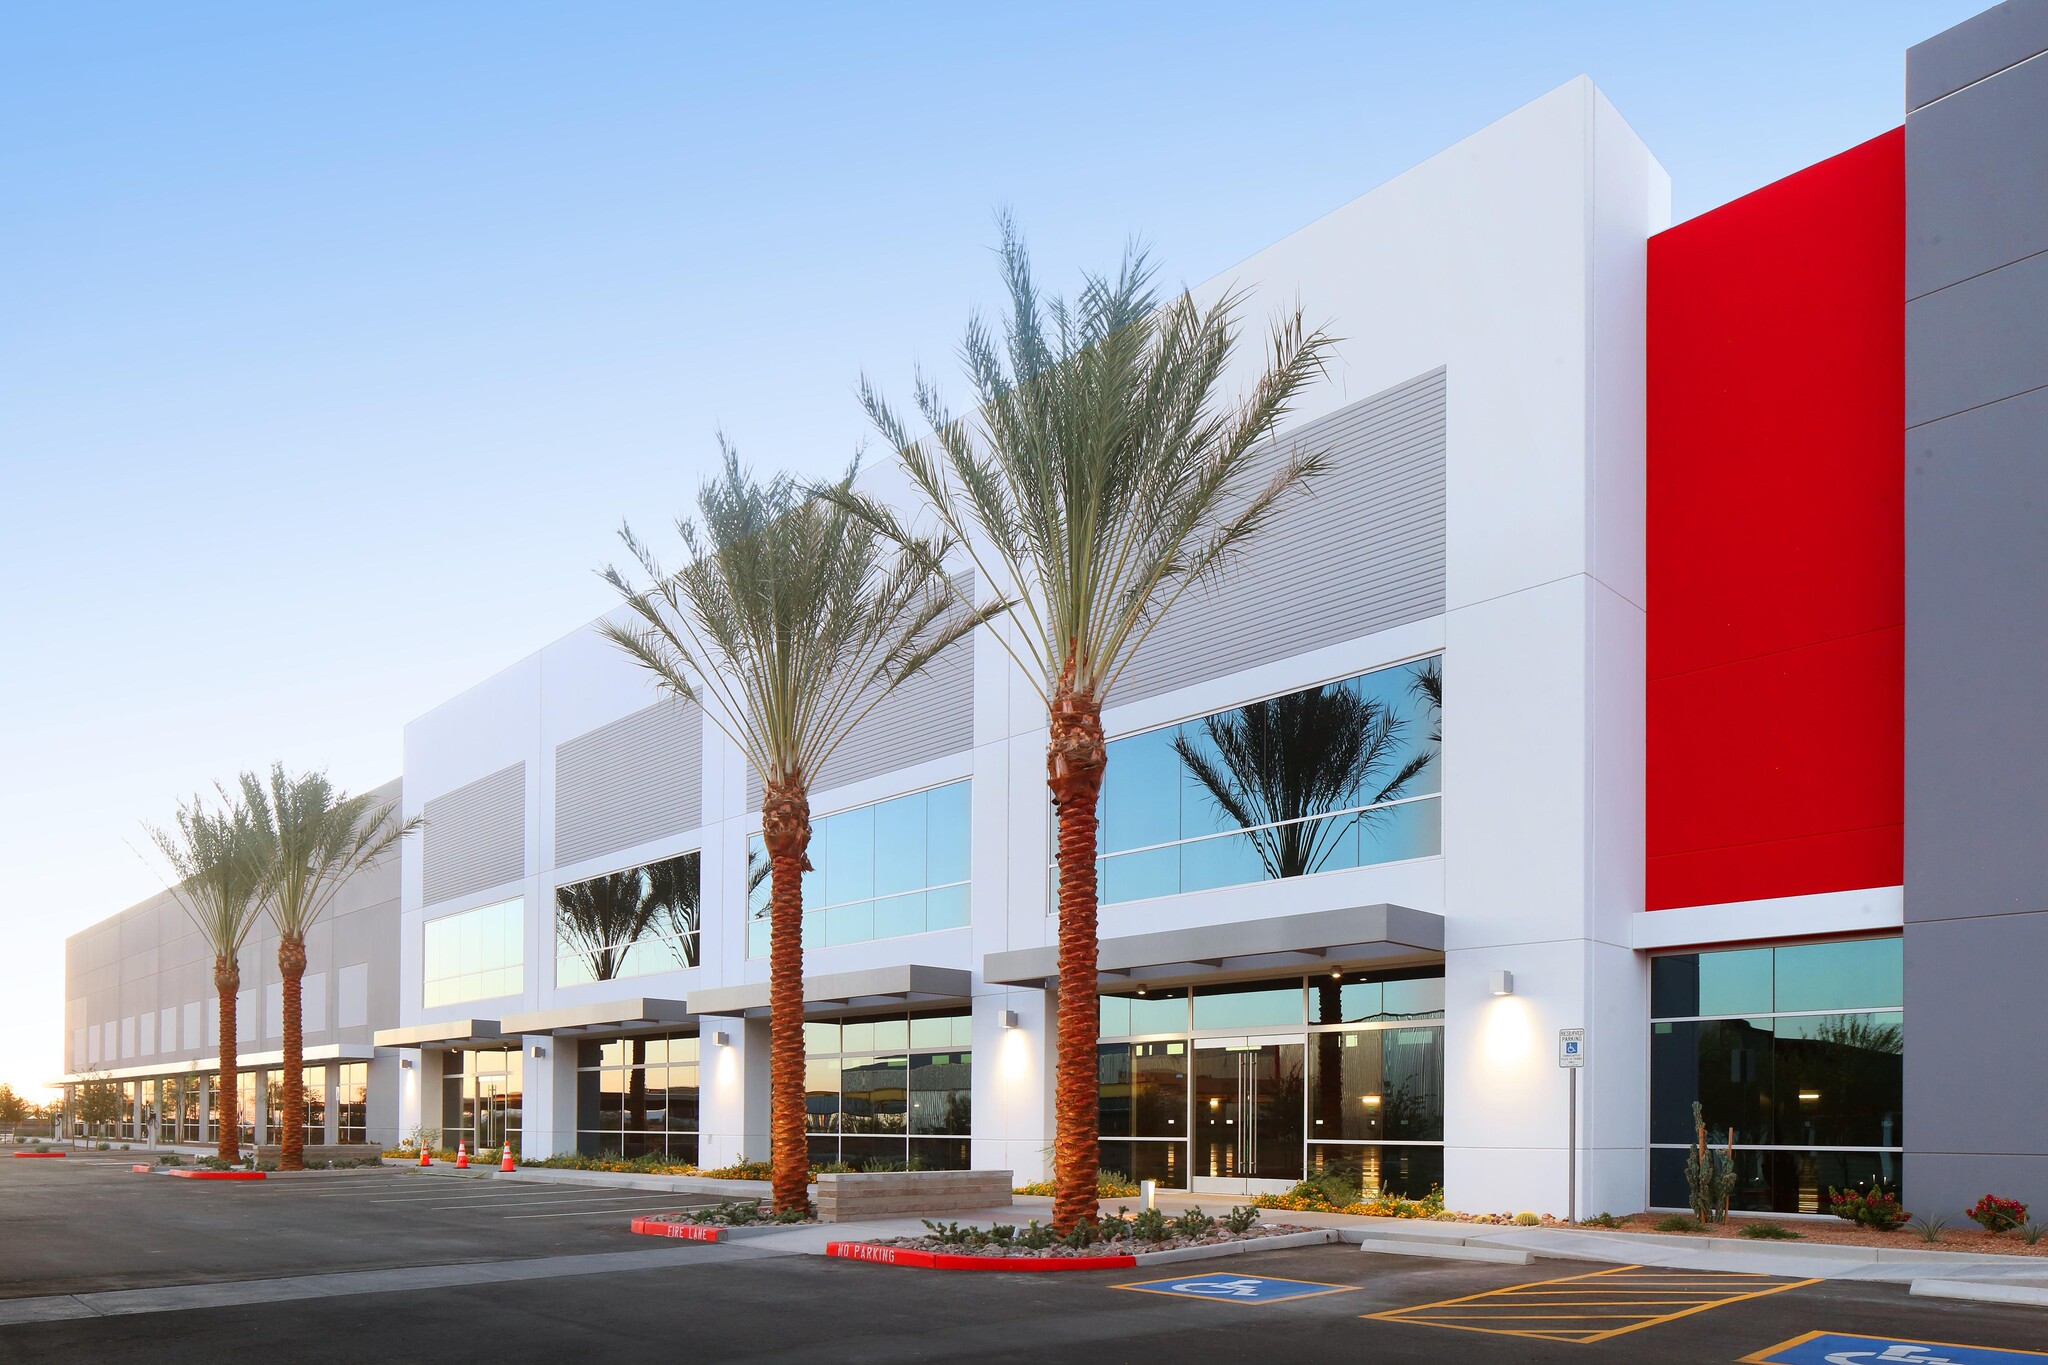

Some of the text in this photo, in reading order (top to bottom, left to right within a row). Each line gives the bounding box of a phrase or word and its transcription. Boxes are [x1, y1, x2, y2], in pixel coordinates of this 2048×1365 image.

[667, 1225, 708, 1240] FIRE LANE
[837, 1243, 895, 1263] NO PARKING
